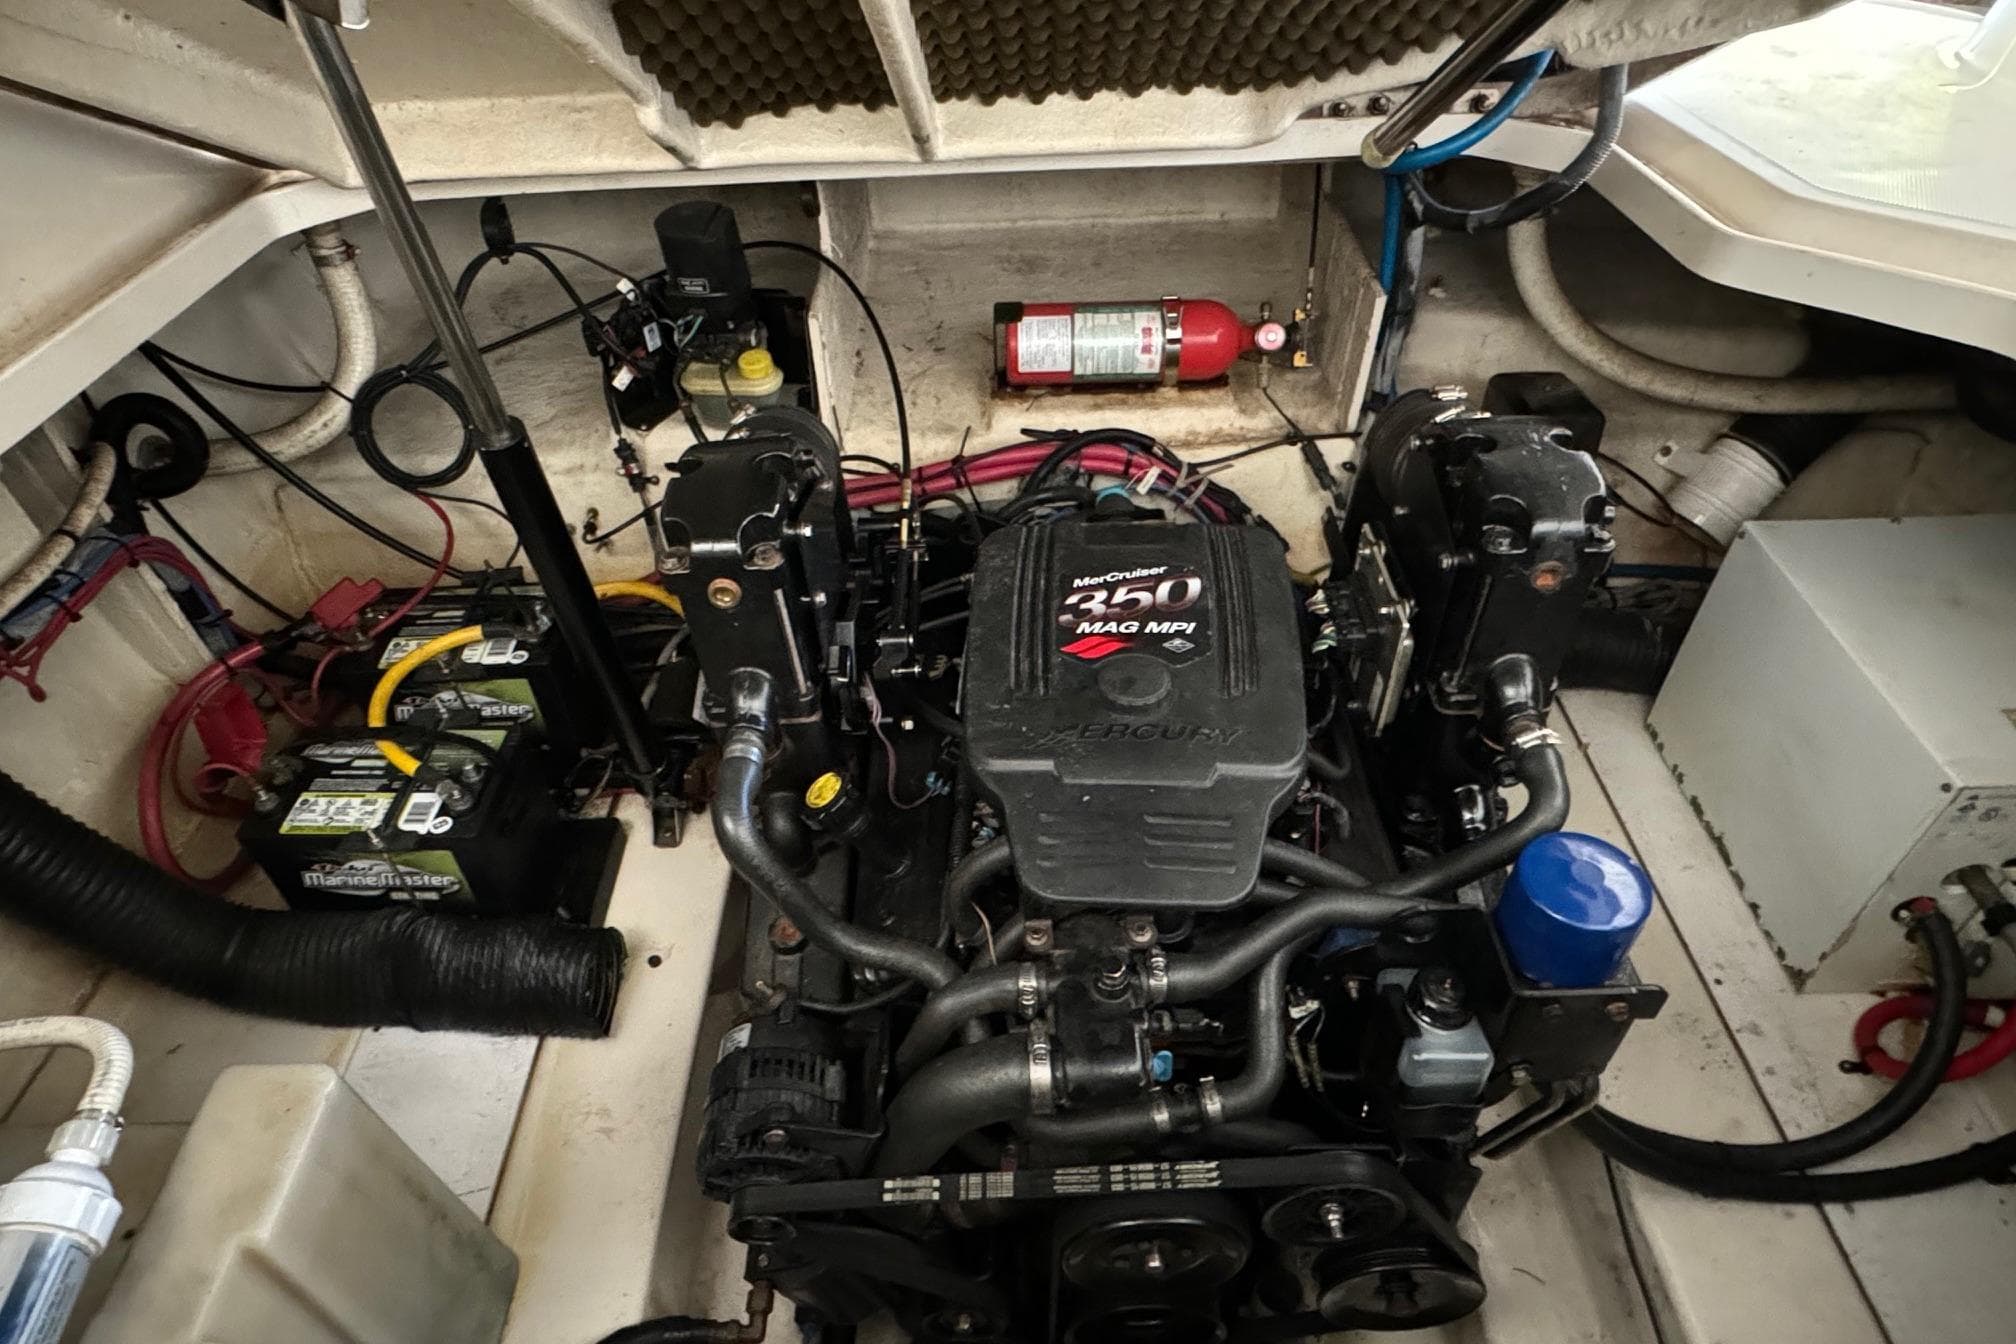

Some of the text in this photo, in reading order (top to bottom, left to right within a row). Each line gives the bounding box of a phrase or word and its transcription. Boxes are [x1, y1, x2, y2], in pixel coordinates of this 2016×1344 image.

[1073, 566, 1168, 588] MerCruiser
[1057, 576, 1202, 627] 350
[1076, 621, 1197, 635] MAG MPI
